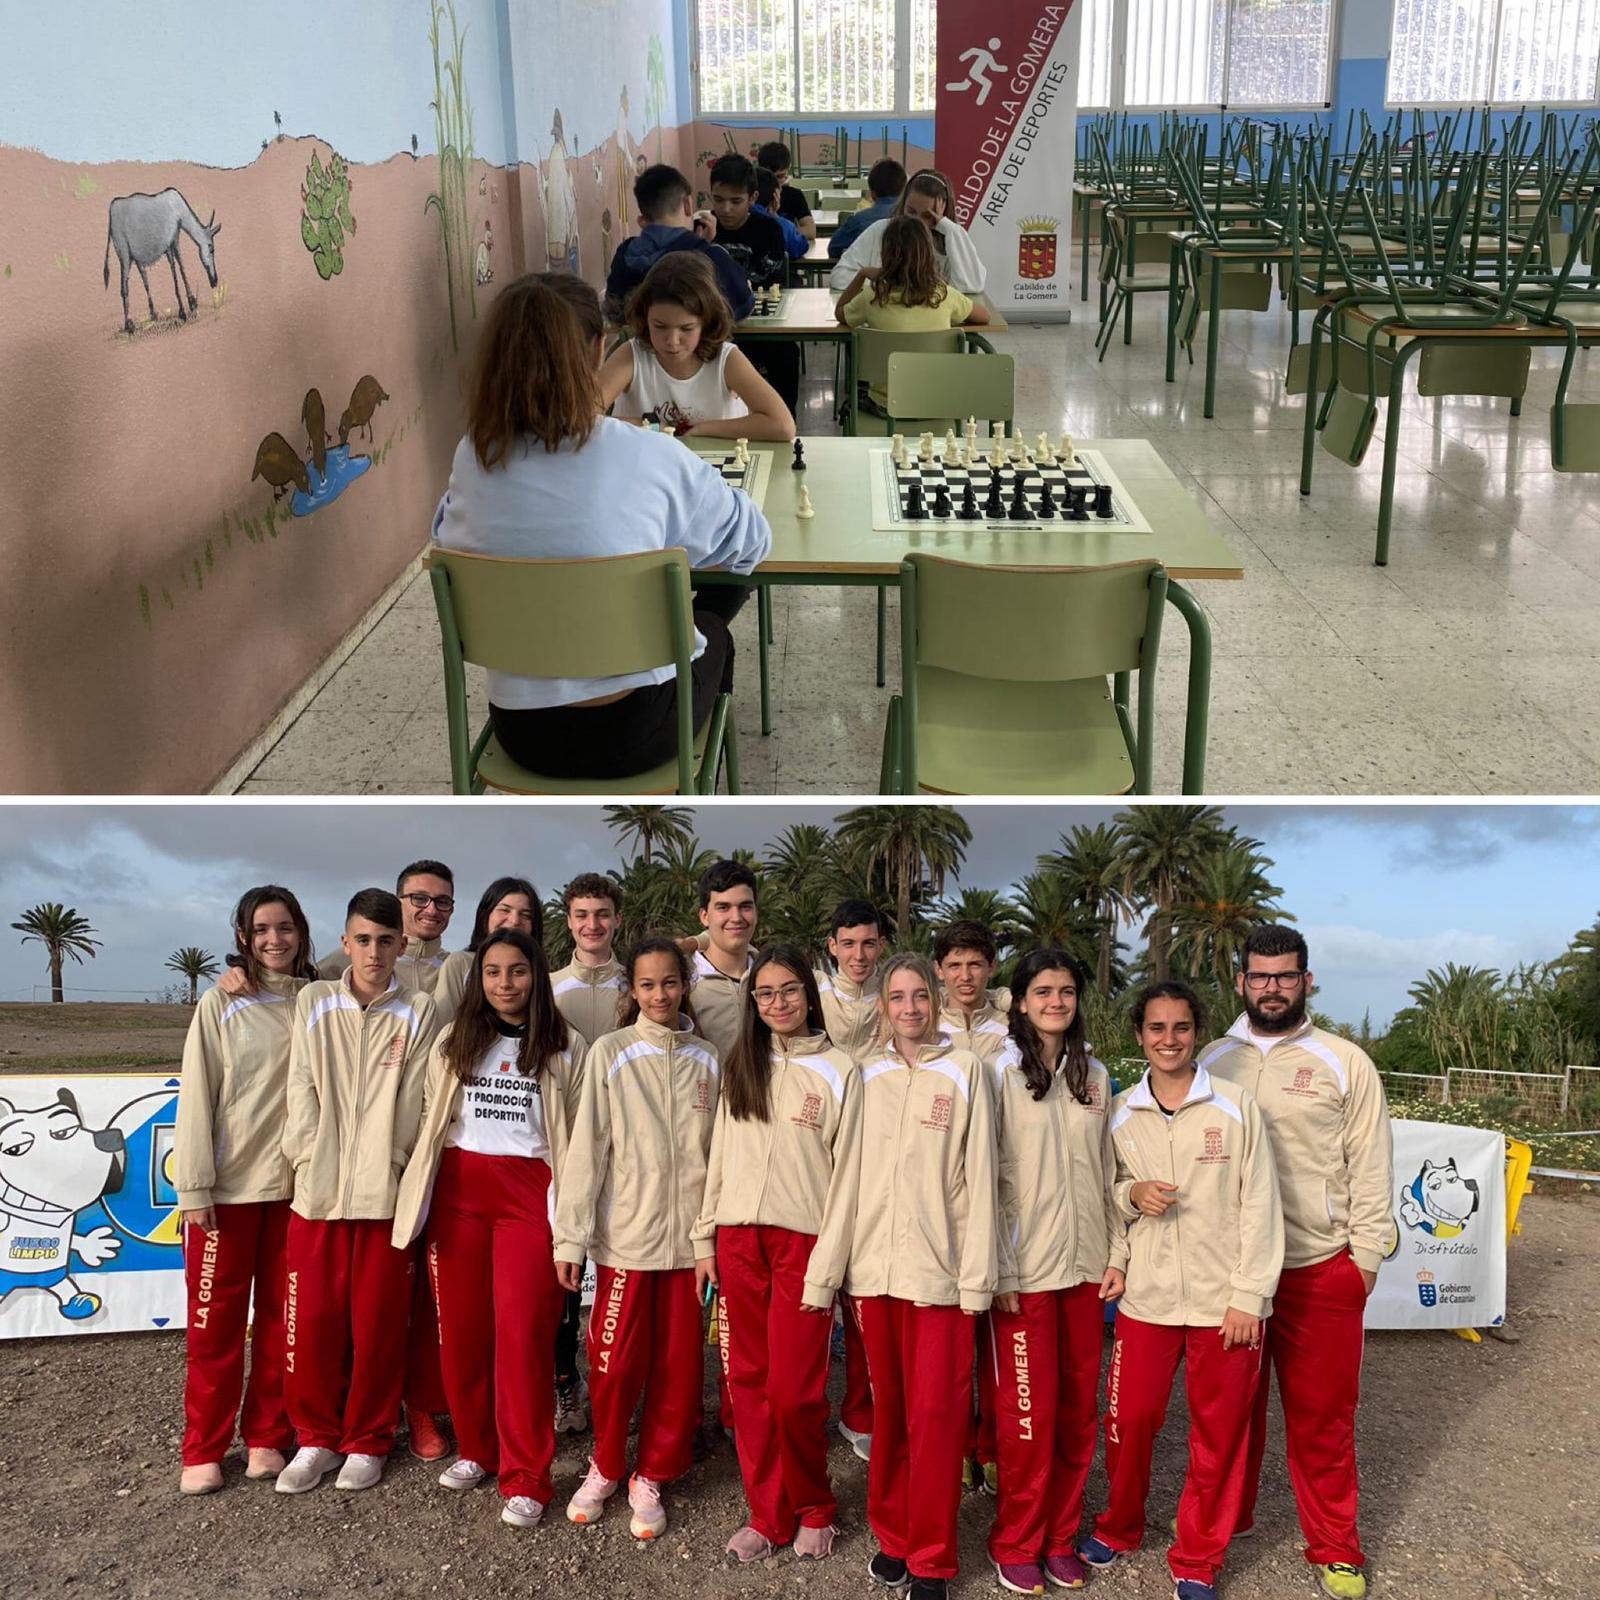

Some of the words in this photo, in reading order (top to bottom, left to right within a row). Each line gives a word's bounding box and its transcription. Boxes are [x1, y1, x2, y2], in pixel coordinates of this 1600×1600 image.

[955, 160, 990, 225] BILDO
[981, 127, 1007, 157] DE
[995, 101, 1021, 126] LA
[1010, 6, 1065, 94] GOMERA
[980, 182, 1013, 226] ÁREA
[1003, 153, 1026, 178] DE
[1015, 61, 1068, 151] DEPORTES
[1014, 292, 1025, 300] La
[1026, 292, 1058, 300] Gomera
[467, 1091, 473, 1102] Y
[474, 1092, 533, 1108] PROMOCIÓN
[475, 1108, 526, 1122] DEPORTIVA
[9, 1247, 59, 1259] LIMPIO
[11, 1236, 60, 1248] JUEGO
[1414, 1240, 1478, 1255] Disfrútalo
[198, 1229, 220, 1303] GOMERA
[582, 1283, 595, 1292] de
[1439, 1283, 1472, 1293] Gobierno
[286, 1271, 298, 1346] GOMERA
[601, 1267, 628, 1345] GOMERA
[1439, 1294, 1449, 1304] de
[193, 1307, 210, 1329] LA
[286, 1351, 295, 1373] LA
[598, 1350, 611, 1374] LA
[1012, 1330, 1032, 1412] GOMERA
[1109, 1339, 1123, 1418] GOMERA
[1019, 1416, 1033, 1440] LA
[1109, 1423, 1120, 1444] LA
